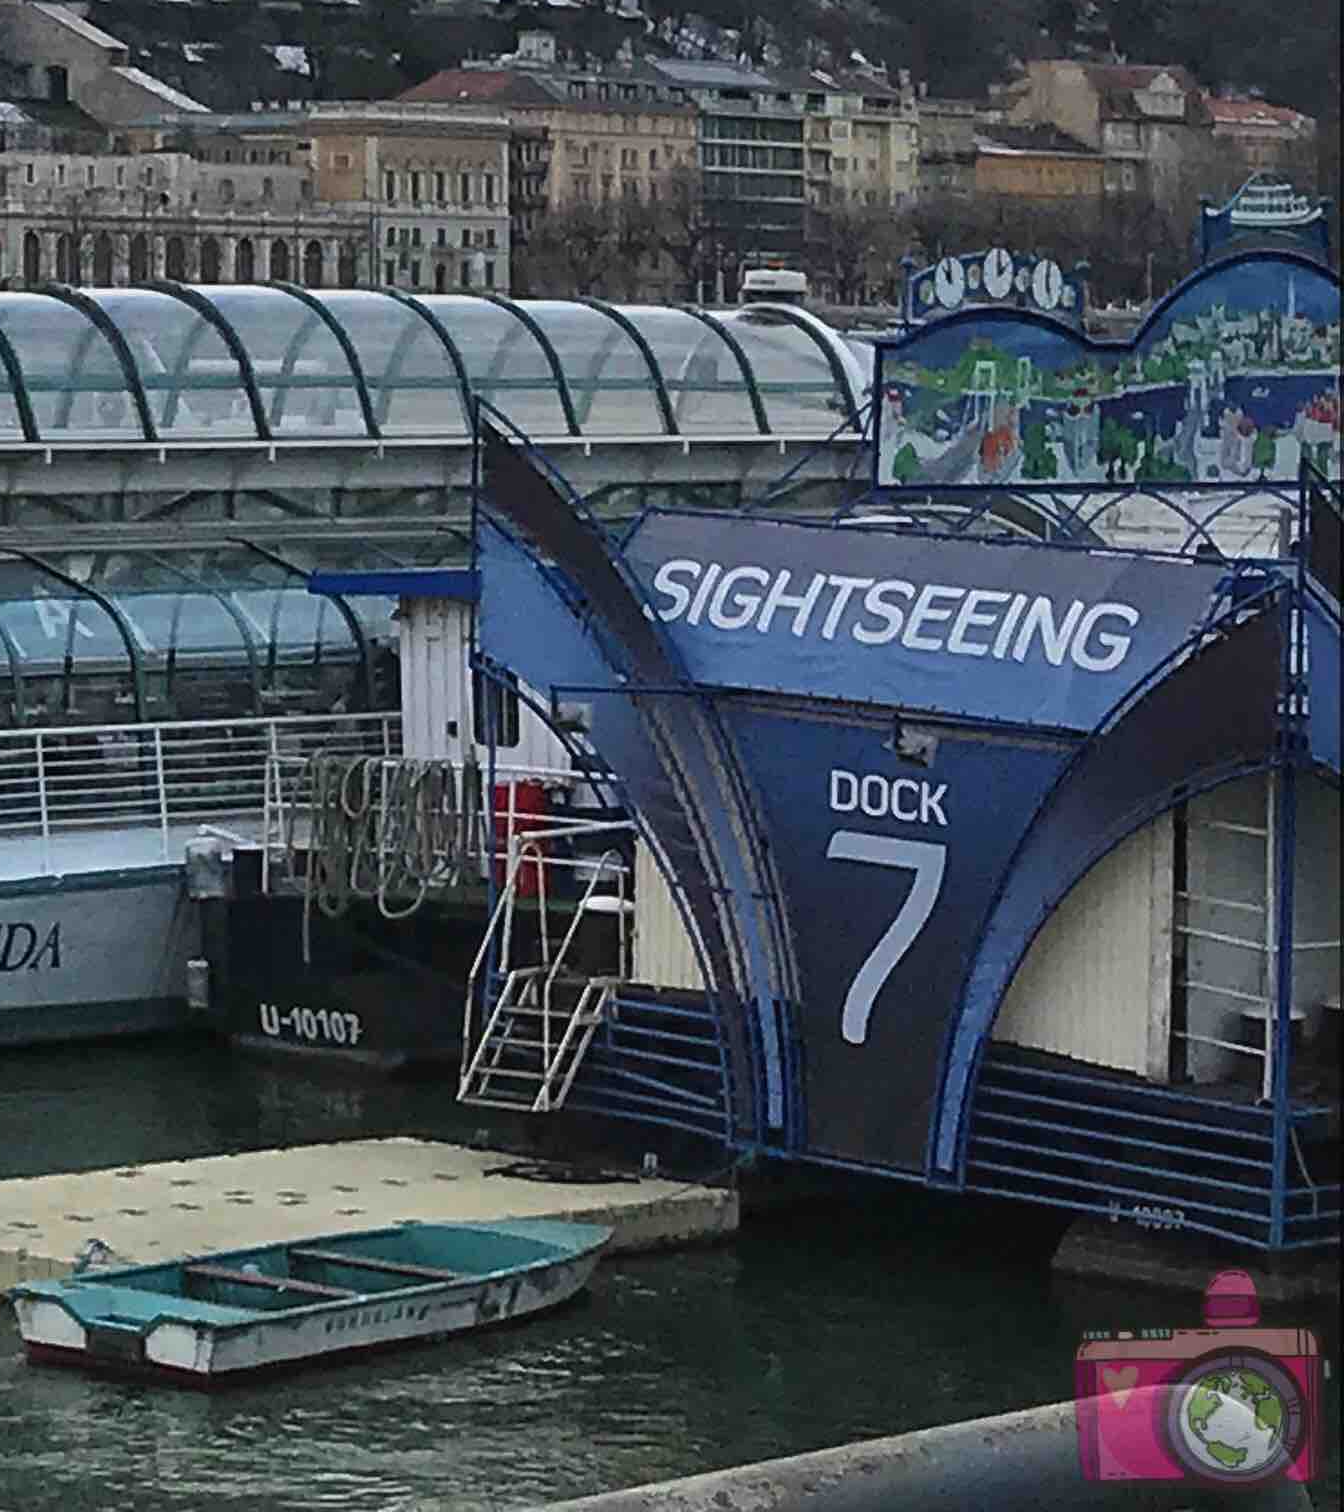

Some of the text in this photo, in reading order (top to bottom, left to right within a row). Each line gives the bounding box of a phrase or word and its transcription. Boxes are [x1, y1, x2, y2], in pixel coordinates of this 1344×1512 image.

[643, 559, 1140, 673] SIGHTSEEING
[829, 769, 948, 826] DOCK
[826, 829, 947, 1045] 7
[259, 1003, 363, 1045] U-10107
